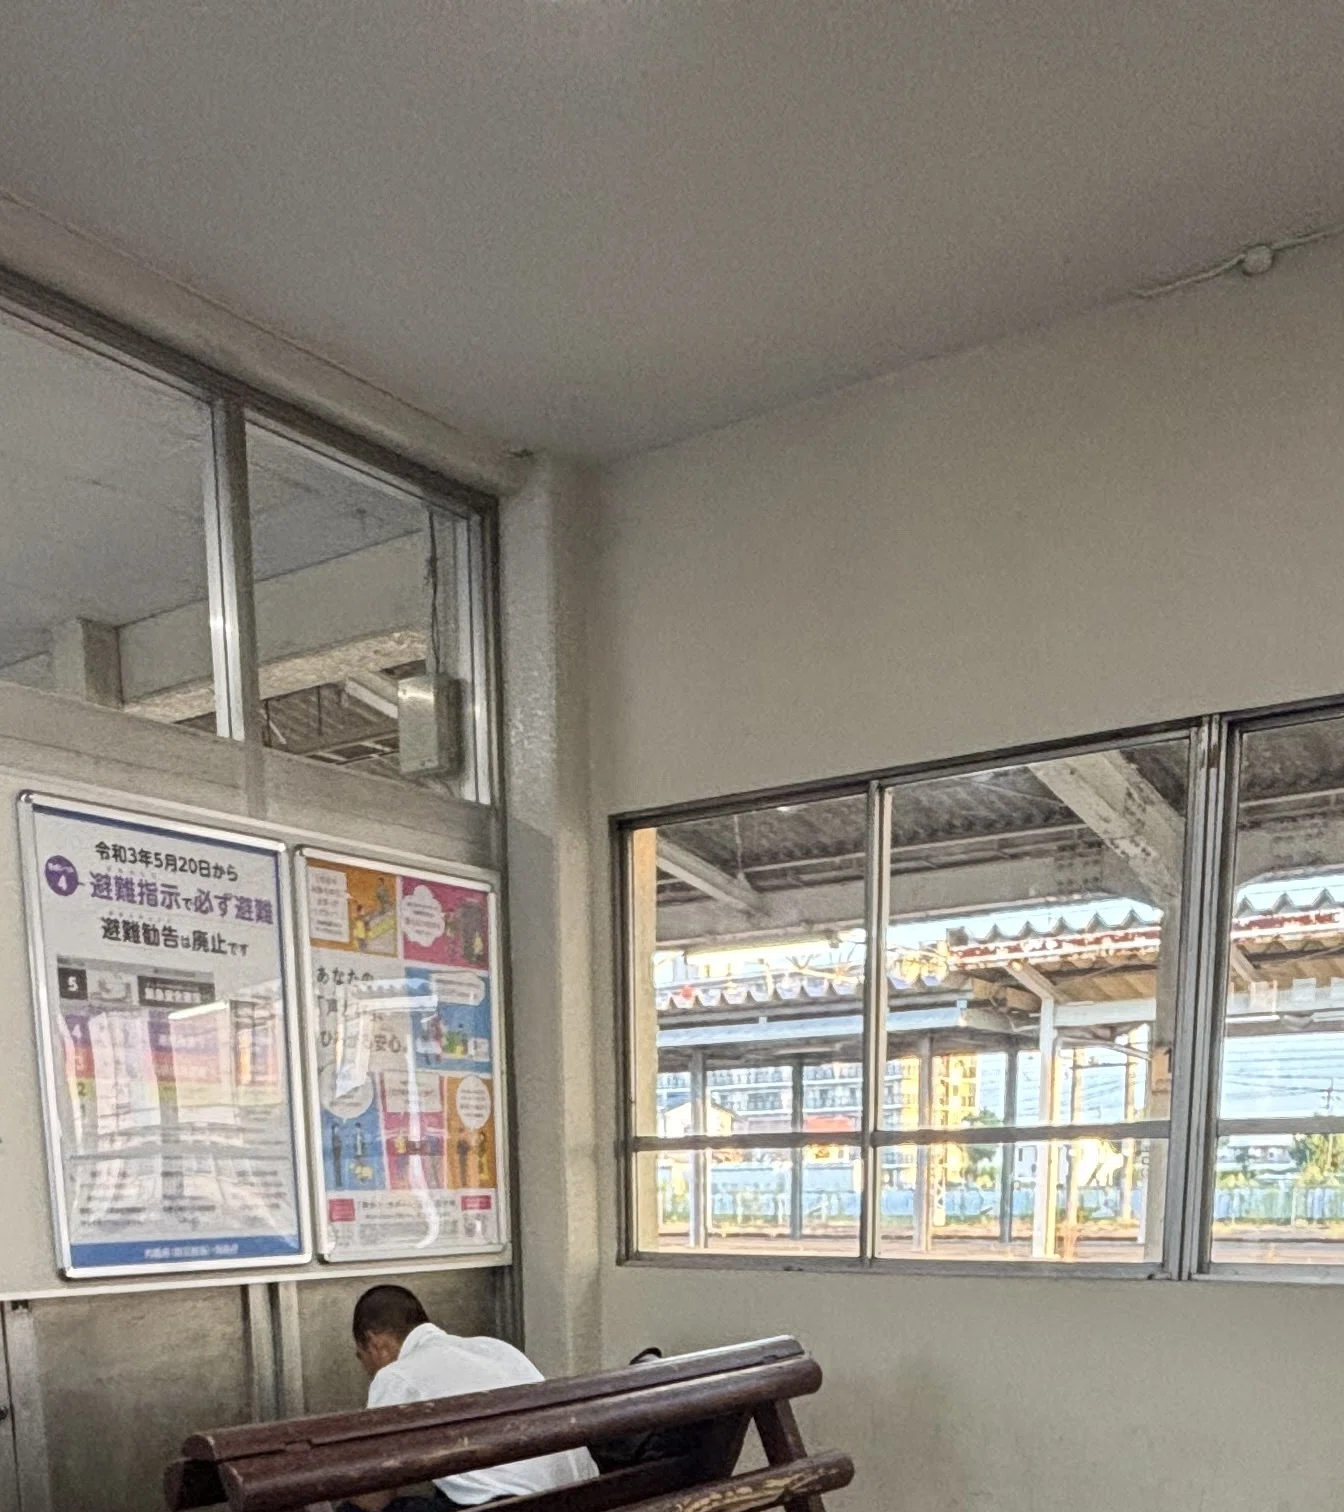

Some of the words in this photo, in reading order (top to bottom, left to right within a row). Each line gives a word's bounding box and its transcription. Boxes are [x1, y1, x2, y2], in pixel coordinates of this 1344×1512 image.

[94, 840, 239, 882] 令和3年5月20日から
[57, 874, 68, 891] 4
[89, 871, 274, 925] 避難指示で必ず避難
[101, 916, 249, 957] 避難勧告は廃止です
[67, 976, 78, 992] 5
